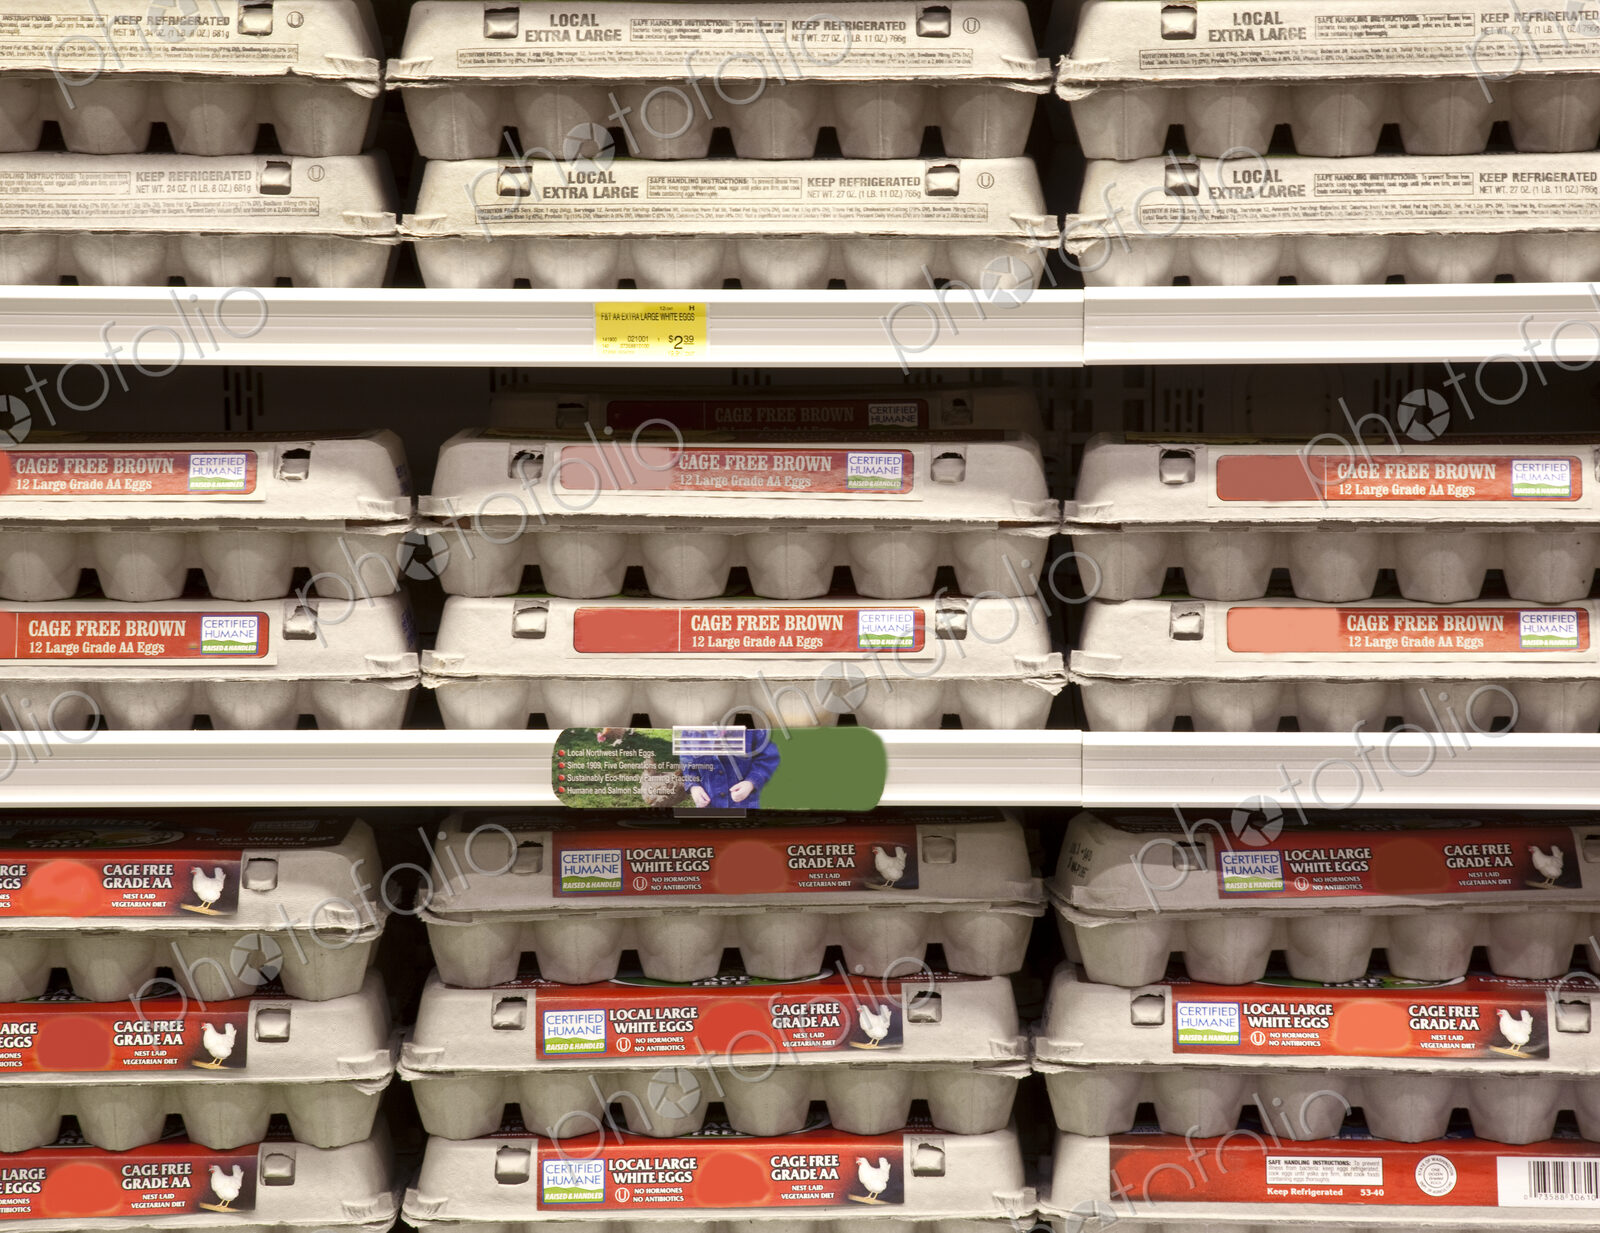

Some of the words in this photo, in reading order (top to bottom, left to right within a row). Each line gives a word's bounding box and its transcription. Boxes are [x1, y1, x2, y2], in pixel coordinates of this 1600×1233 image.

[114, 16, 143, 26] KEEP
[146, 16, 230, 26] REFRIGERATED
[550, 14, 599, 27] LOCAL
[1233, 11, 1283, 25] LOCAL
[1481, 14, 1510, 23] KEEP
[1514, 11, 1599, 22] REFRIGERATED
[792, 20, 820, 31] KEEP
[824, 20, 907, 31] REFRIGERATED
[525, 29, 570, 42] EXTRA
[572, 29, 622, 42] LARGE
[1208, 29, 1255, 42] EXTRA
[1260, 28, 1307, 41] LARGE
[136, 171, 165, 182] KEEP
[168, 171, 252, 182] REFRIGERATED
[568, 171, 616, 184] LOCAL
[807, 176, 836, 188] KEEP
[839, 176, 921, 188] REFRIGERATED
[1233, 170, 1283, 184] LOCAL
[1480, 172, 1508, 183] KEEP
[1512, 172, 1598, 182] REFRIGERATED
[543, 186, 590, 199] EXTRA
[593, 186, 639, 199] LARGE
[1209, 186, 1255, 200] EXTRA
[1260, 184, 1306, 198] LARGE
[613, 313, 620, 321] AA
[622, 313, 639, 321] EXTRA
[640, 313, 659, 321] LARGE
[660, 313, 678, 321] WHITE
[679, 313, 695, 321] EGGS
[715, 407, 752, 422] CAGE
[756, 407, 794, 422] FREE
[799, 407, 854, 422] BROWN
[16, 458, 61, 474] CAGE
[64, 458, 110, 474] FREE
[113, 458, 174, 474] BROWN
[192, 456, 245, 466] CERTIFIED
[679, 454, 720, 471] CAGE
[725, 455, 768, 471] FREE
[773, 456, 832, 472] BROWN
[193, 466, 243, 476] HUMANE
[1338, 463, 1380, 480] CAGE
[1384, 463, 1430, 480] FREE
[1435, 463, 1496, 480] BROWN
[16, 478, 30, 490] 12
[32, 478, 68, 492] Large
[70, 478, 104, 490] Grade
[106, 478, 121, 490] AA
[123, 478, 153, 492] Eggs
[203, 619, 257, 630] CERTIFIED
[691, 615, 732, 631] CAGE
[737, 615, 781, 631] FREE
[785, 615, 844, 631] BROWN
[860, 614, 912, 623] CERTIFIED
[1347, 615, 1388, 632] CAGE
[1394, 615, 1439, 632] FREE
[1443, 615, 1505, 632] BROWN
[1522, 614, 1576, 624] CERTIFIED
[28, 620, 71, 637] CAGE
[76, 620, 122, 637] FREE
[125, 620, 186, 637] BROWN
[205, 629, 255, 639] HUMANE
[862, 624, 911, 633] HUMANE
[1523, 624, 1575, 633] HUMANE
[692, 636, 705, 647] 12
[708, 636, 741, 650] Large
[743, 636, 776, 648] Grade
[779, 636, 794, 648] AA
[796, 636, 823, 650] Eggs
[567, 749, 584, 757] Local
[586, 749, 618, 757] Northwest
[619, 749, 637, 757] Fresh
[638, 749, 656, 759] Eggs.
[567, 762, 585, 770] Since
[604, 762, 617, 770] Five
[619, 762, 656, 770] Generations
[658, 762, 665, 770] of
[567, 774, 604, 783] Sustainably
[605, 774, 642, 783] Eco-friendly
[567, 787, 593, 795] Humane
[594, 787, 606, 795] and
[607, 787, 632, 795] Salmon
[626, 849, 669, 860] LOCAL
[671, 848, 714, 859] LARGE
[787, 845, 826, 857] CAGE
[828, 844, 856, 856] FREE
[1285, 850, 1326, 862] LOCAL
[1329, 848, 1372, 860] LARGE
[1444, 845, 1480, 857] CAGE
[1483, 844, 1511, 856] FREE
[630, 861, 674, 873] WHITE
[676, 860, 710, 872] EGGS
[788, 857, 835, 870] GRADE
[837, 857, 855, 868] AA
[1289, 862, 1332, 874] WHITE
[1334, 860, 1369, 872] EGGS
[1446, 857, 1492, 869] GRADE
[1494, 856, 1514, 868] AA
[103, 864, 141, 876] CAGE
[143, 864, 174, 876] FREE
[103, 878, 151, 890] GRADE
[152, 878, 173, 889] AA
[609, 1008, 653, 1021] LOCAL
[655, 1007, 698, 1019] LARGE
[772, 1004, 808, 1016] CAGE
[810, 1003, 840, 1014] FREE
[1243, 1003, 1286, 1016] LOCAL
[1289, 1003, 1334, 1016] LARGE
[1409, 1005, 1446, 1018] CAGE
[1448, 1006, 1480, 1018] FREE
[114, 1021, 152, 1033] CAGE
[153, 1021, 185, 1032] FREE
[614, 1021, 658, 1034] WHITE
[660, 1020, 694, 1032] EGGS
[772, 1017, 818, 1029] GRADE
[820, 1016, 840, 1027] AA
[1248, 1016, 1292, 1029] WHITE
[1293, 1016, 1329, 1029] EGGS
[1410, 1018, 1457, 1030] GRADE
[1459, 1019, 1480, 1031] AA
[114, 1034, 162, 1046] GRADE
[164, 1034, 184, 1045] AA
[546, 1043, 569, 1051] RAISED
[609, 1158, 652, 1170] LOCAL
[654, 1157, 698, 1169] LARGE
[770, 1156, 807, 1169] CAGE
[809, 1155, 840, 1167] FREE
[613, 1171, 658, 1184] WHITE
[660, 1171, 693, 1183] EGGS
[771, 1169, 818, 1182] GRADE
[820, 1168, 839, 1180] AA
[1267, 1188, 1288, 1196] Keep
[1291, 1188, 1343, 1197] Refrigerated
